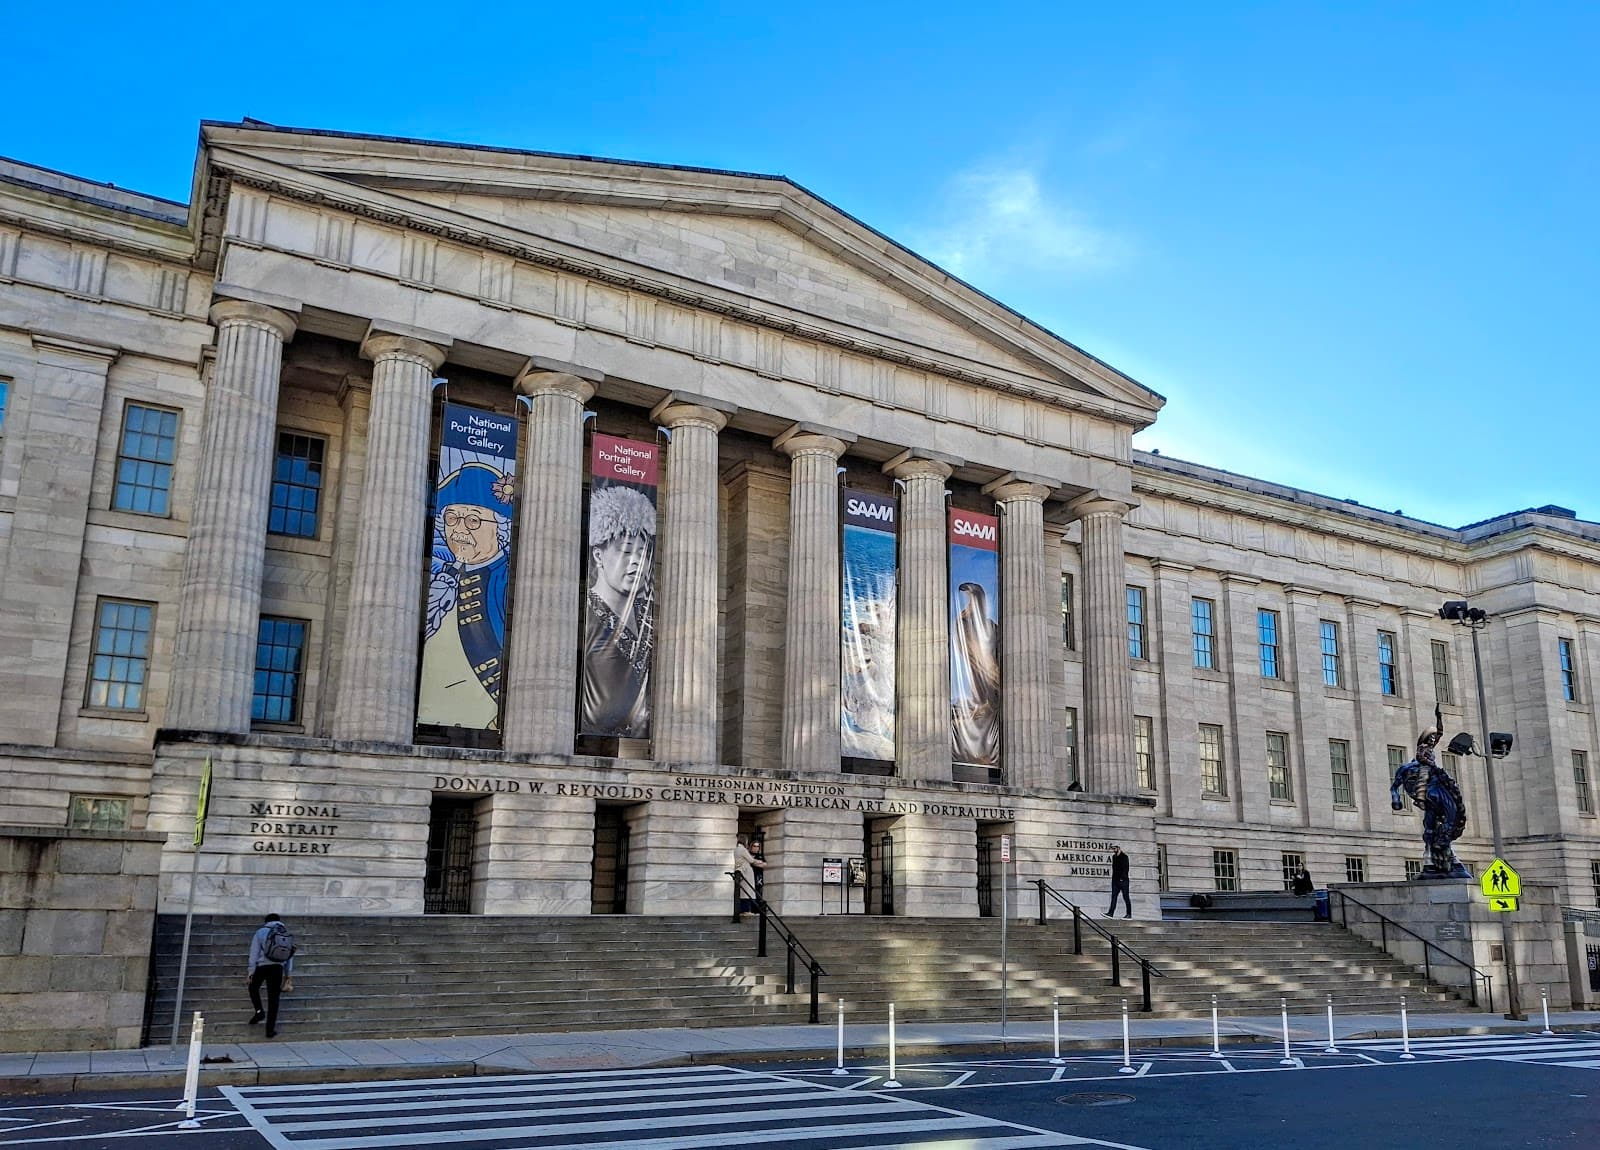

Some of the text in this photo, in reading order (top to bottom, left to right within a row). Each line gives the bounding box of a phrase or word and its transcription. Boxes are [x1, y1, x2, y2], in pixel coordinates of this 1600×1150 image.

[451, 422, 488, 437] Portrait
[469, 415, 511, 433] National
[467, 436, 504, 453] Gallery
[599, 451, 631, 465] Portrait
[614, 445, 652, 460] National
[614, 464, 647, 479] Gallery
[847, 499, 894, 523] SAAM
[953, 519, 996, 541] SAAM
[675, 777, 845, 795] SMITHSONIAN INSTITUTION
[435, 776, 1015, 820] DONALD W. REYNOLDS CENTER FOR AMERICAN ART AND PORTRAITURE
[250, 803, 341, 818] NATIONAL
[250, 822, 338, 836] PORTRAIT
[253, 841, 331, 854] GALLERY
[1056, 853, 1103, 863] AMERICAN
[1071, 867, 1110, 876] MUSEUM
